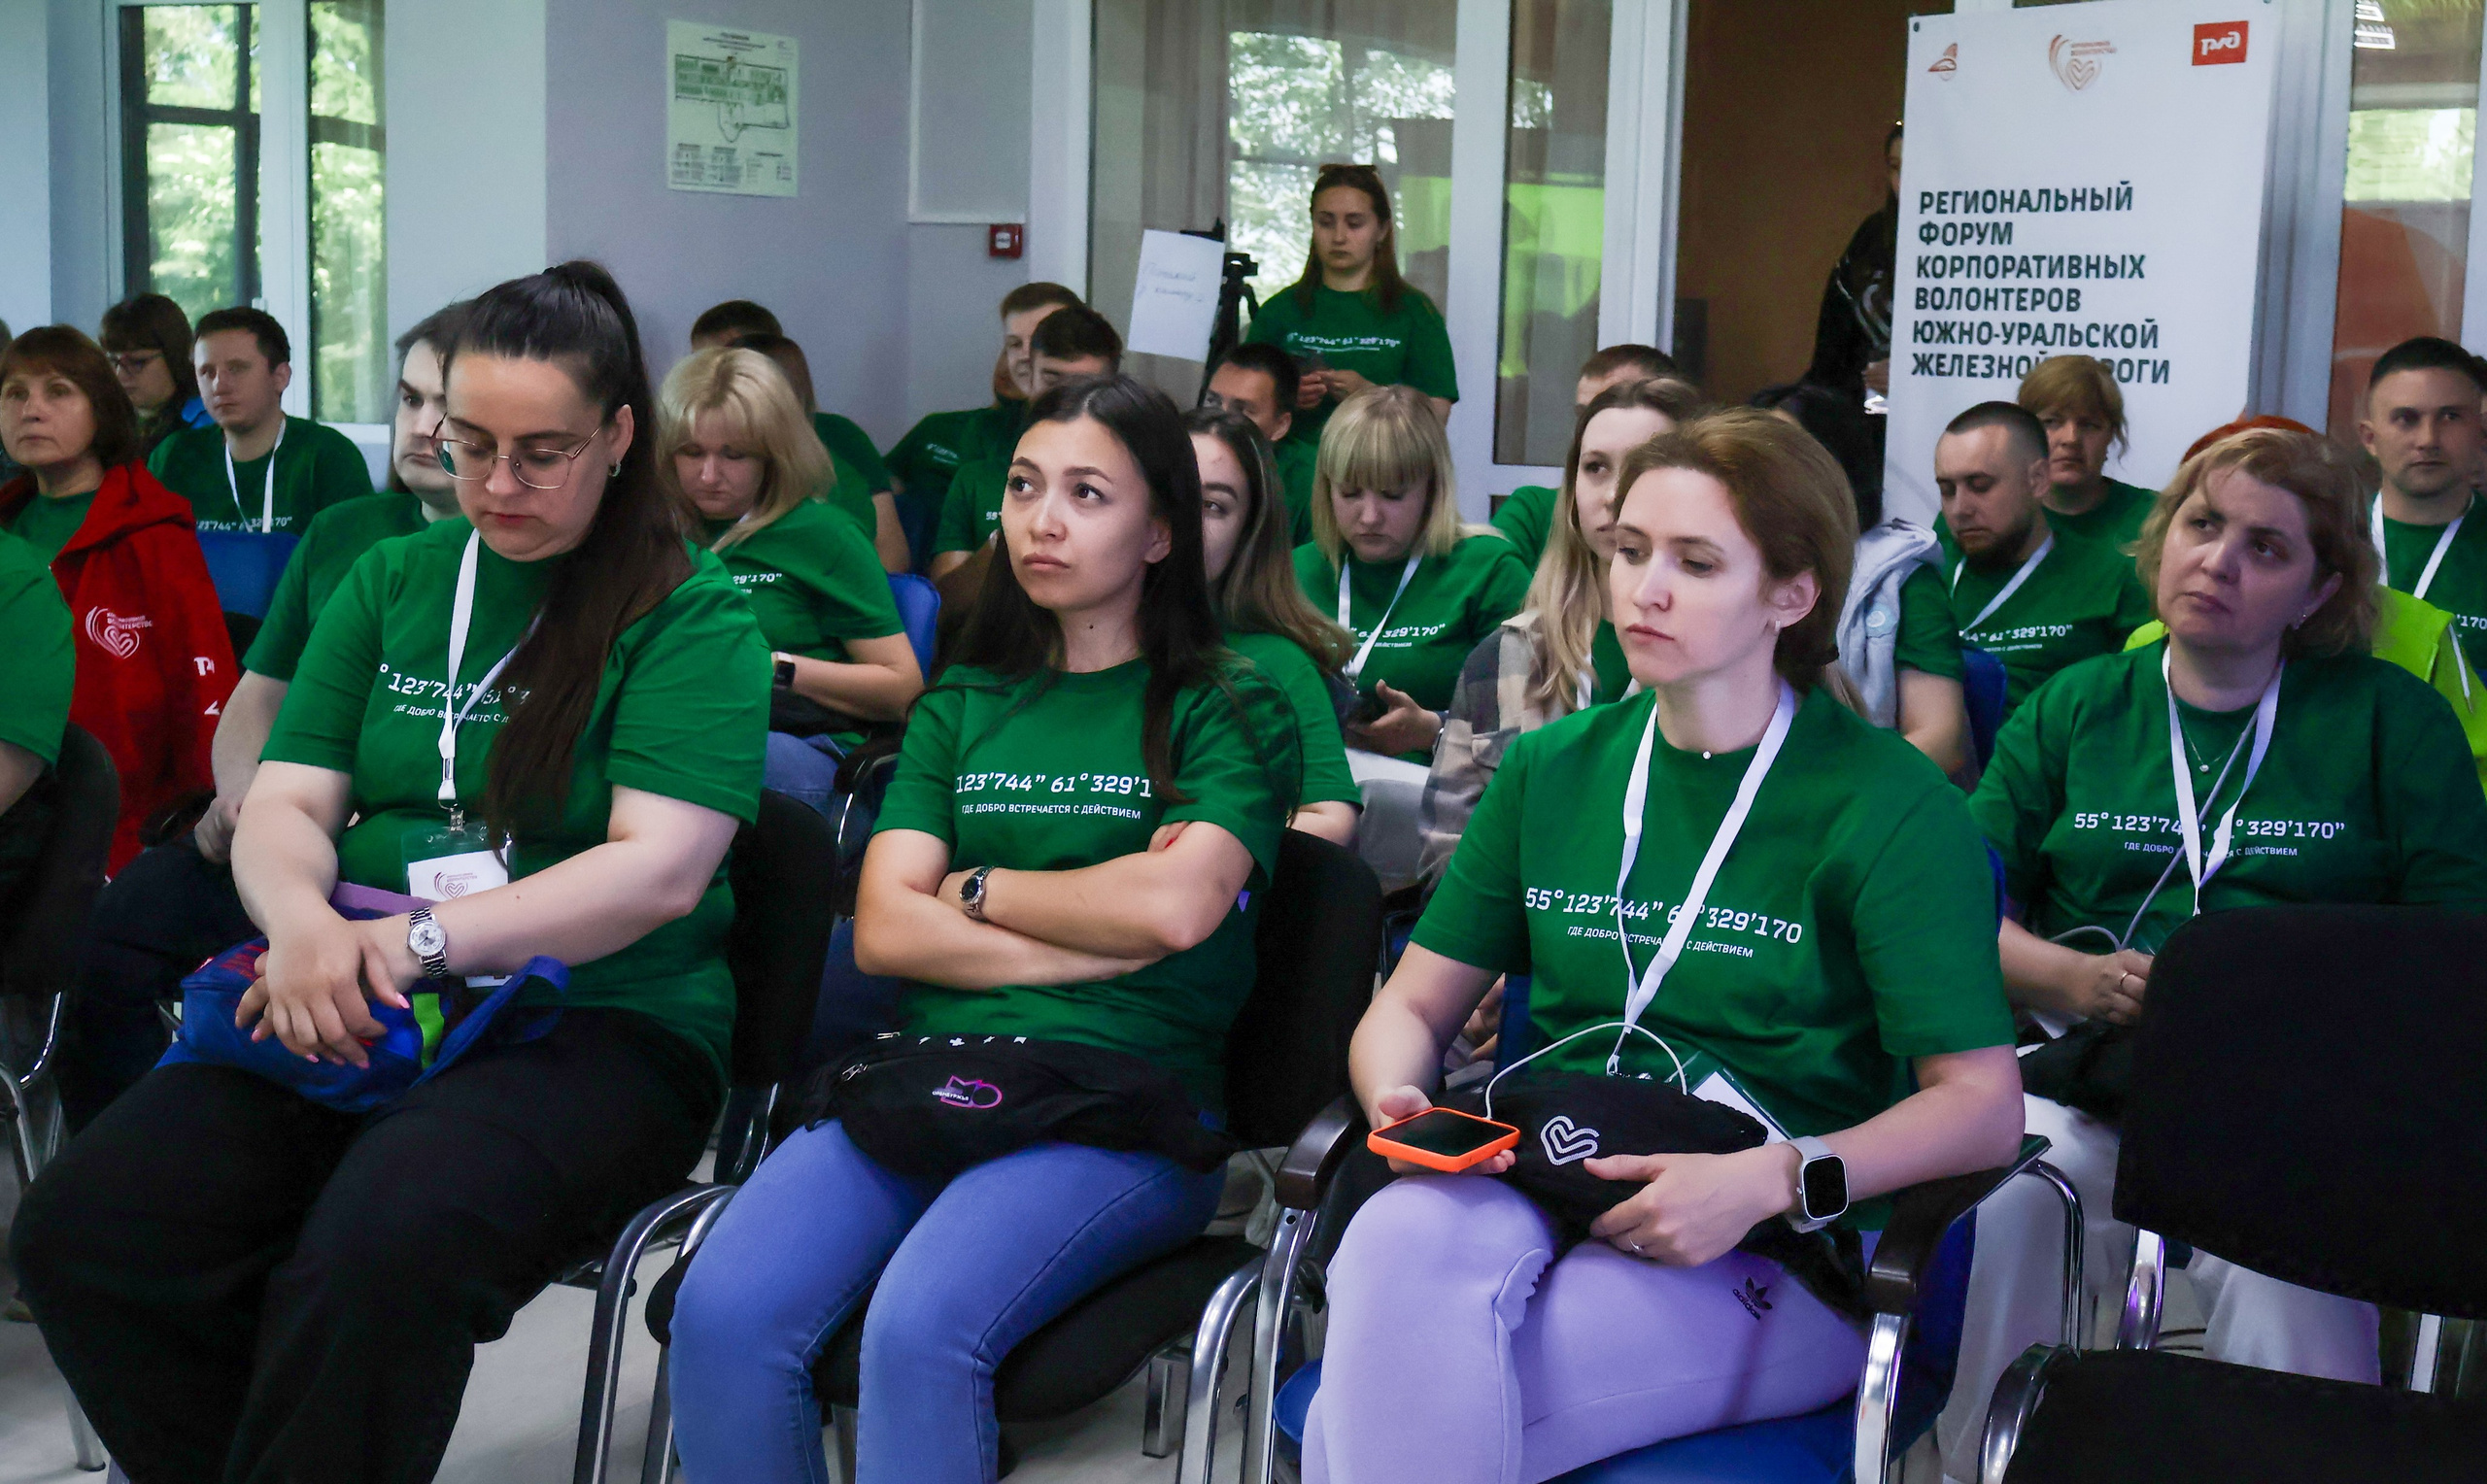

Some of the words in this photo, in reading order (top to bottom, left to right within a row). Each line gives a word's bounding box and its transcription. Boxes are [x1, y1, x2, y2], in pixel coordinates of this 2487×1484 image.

[1919, 180, 2133, 215] РЕГИОНАЛЬНЫЙ
[1919, 220, 2013, 247] ФОРУМ
[1916, 253, 2146, 280] КОРПОРАТИВНЫХ
[1915, 287, 2081, 313] ВОЛОНТЕРОВ
[1912, 318, 2159, 349] ЮЖНО-УРАЛЬСКОЙ
[974, 803, 1006, 814] ДОБРО
[1008, 804, 1071, 814] ВСТРЕЧАЕТСЯ
[1073, 805, 1079, 814] С
[1080, 804, 1141, 820] ДЕЙСТВИЕМ
[2124, 841, 2141, 851] ГДЕ
[2142, 843, 2174, 854] ДОБРО
[1567, 926, 1584, 937] ГДЕ
[1584, 928, 1618, 940] ДОБРО
[1686, 940, 1692, 950] С
[1692, 940, 1754, 958] ДЕЙСТВИЕМ
